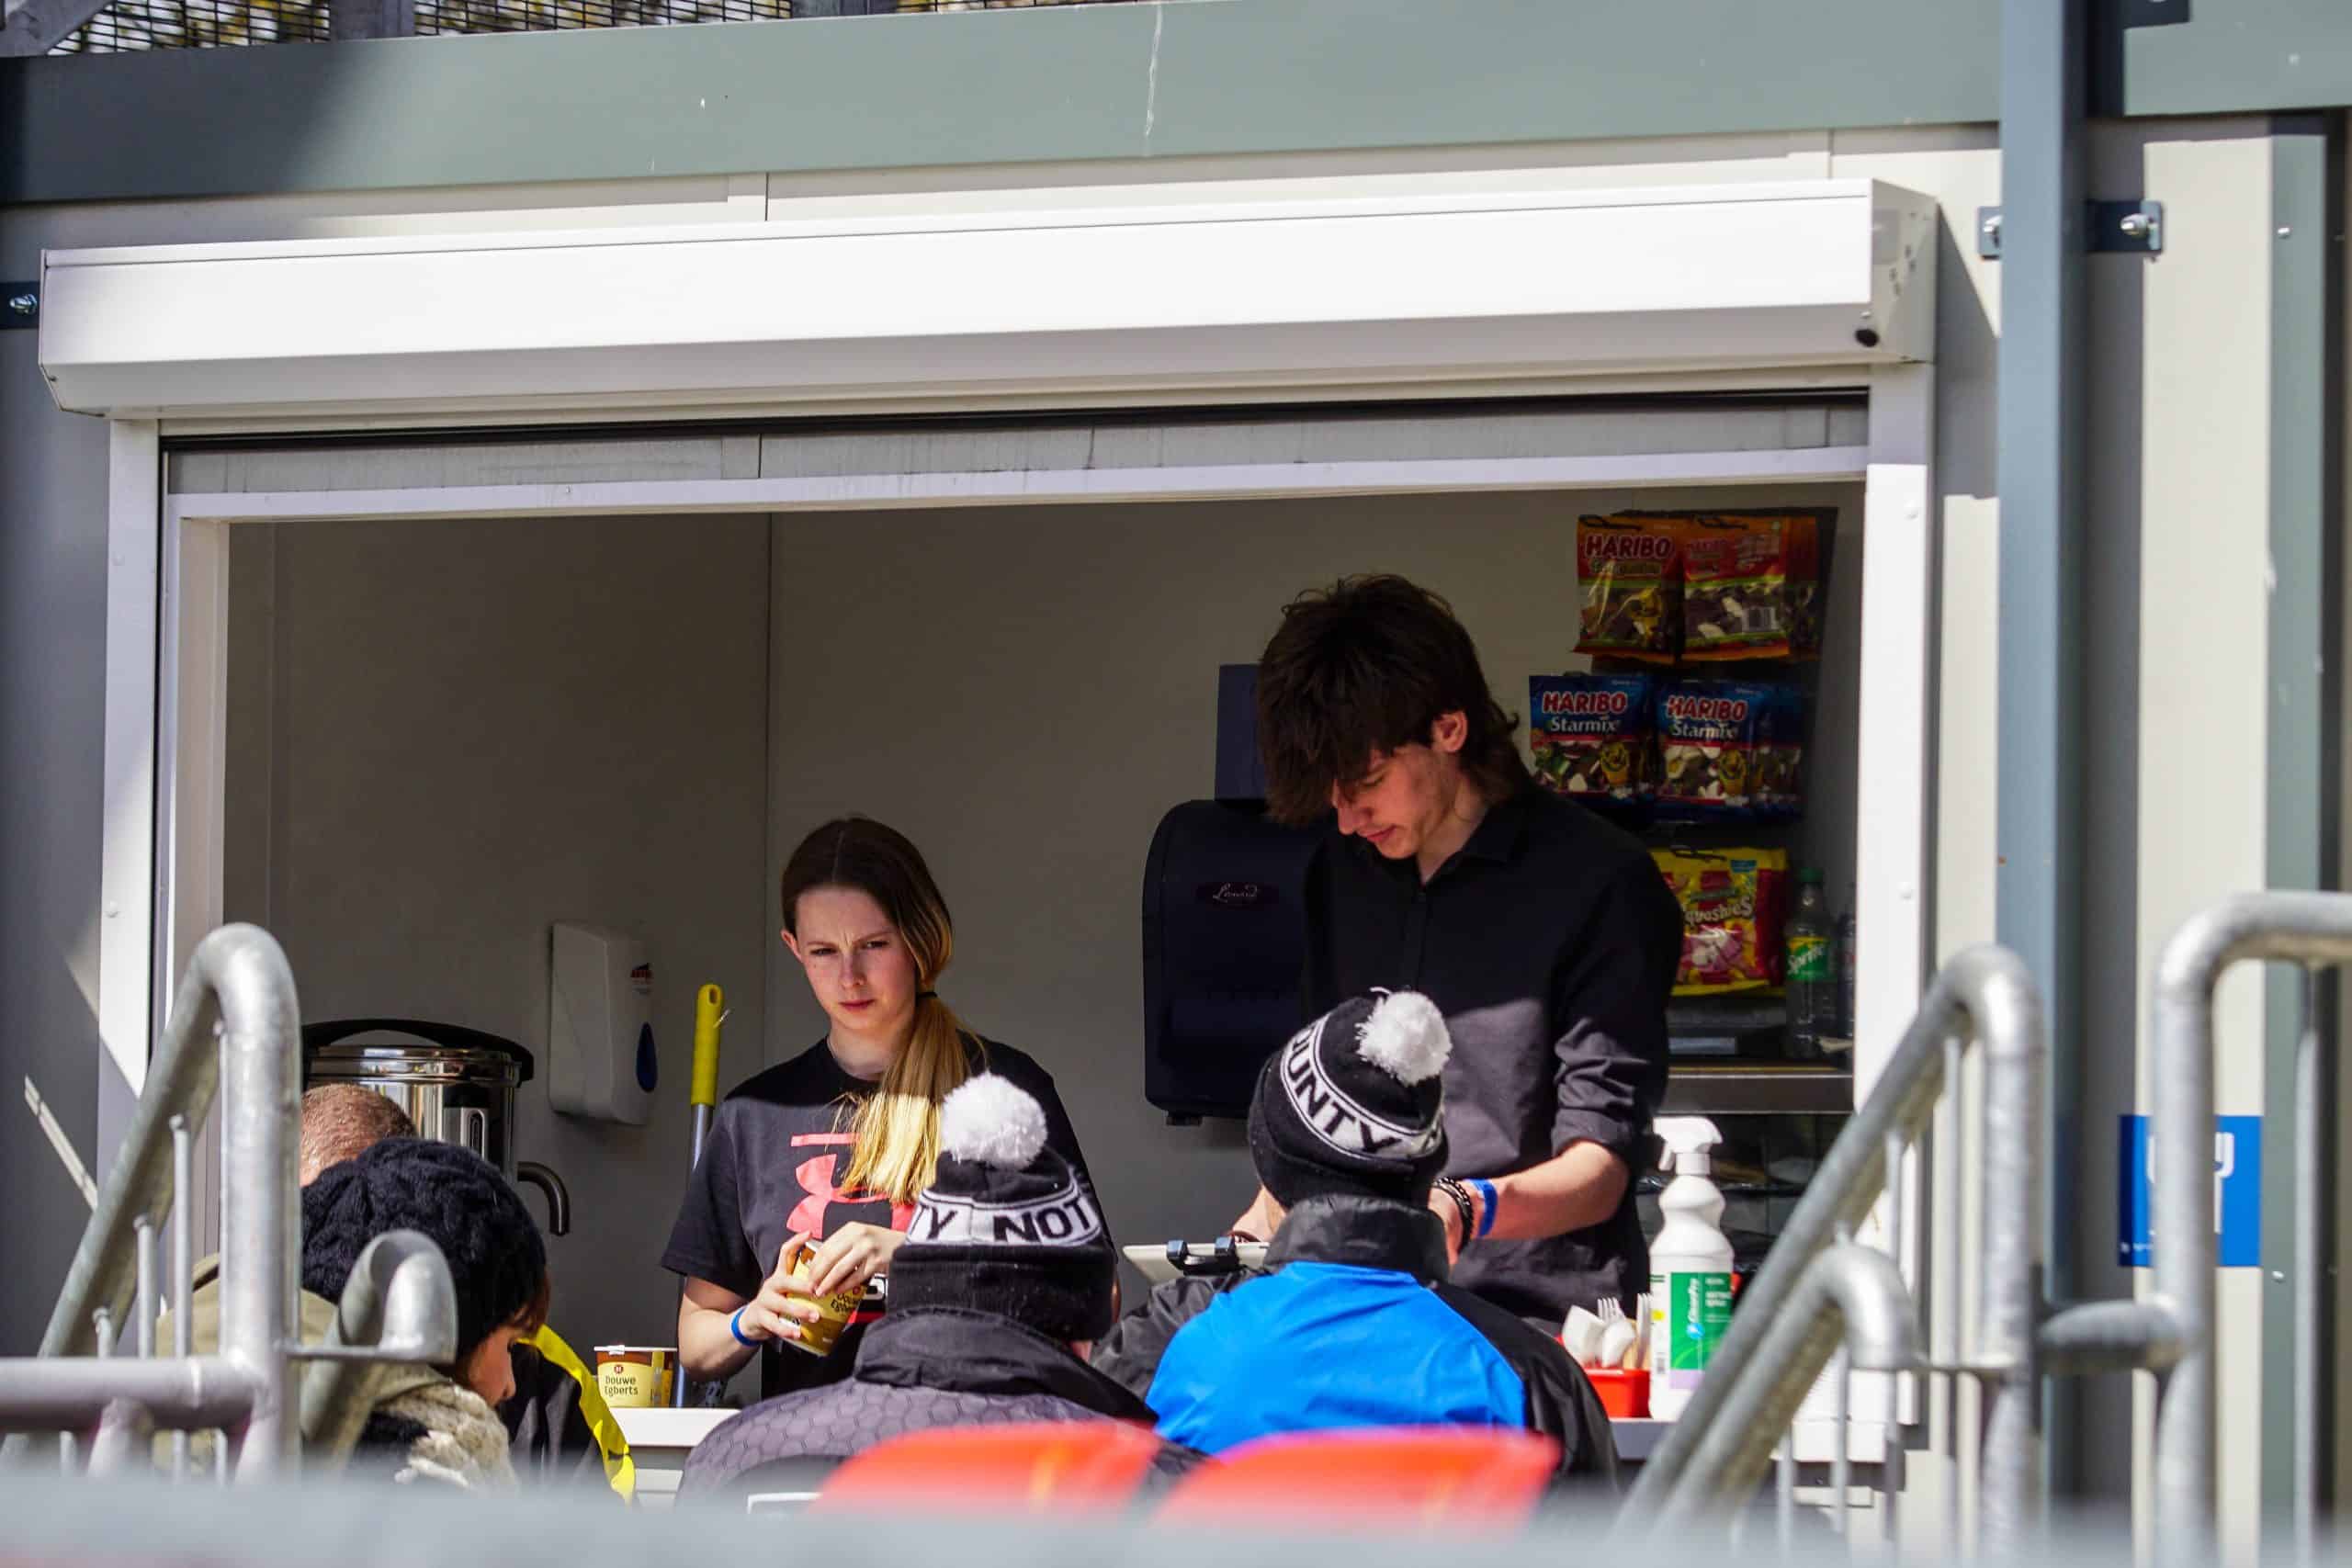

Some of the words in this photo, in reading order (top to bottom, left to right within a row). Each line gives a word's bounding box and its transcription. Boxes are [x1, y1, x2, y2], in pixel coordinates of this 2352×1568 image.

[1585, 534, 1673, 559] HARIBO
[1542, 691, 1628, 715] HARIBO
[1666, 694, 1749, 722] HARIBO
[1550, 716, 1617, 735] Starmix
[1672, 720, 1736, 741] Starmix
[605, 1376, 636, 1385] Douwe
[605, 1386, 638, 1396] Egberts
